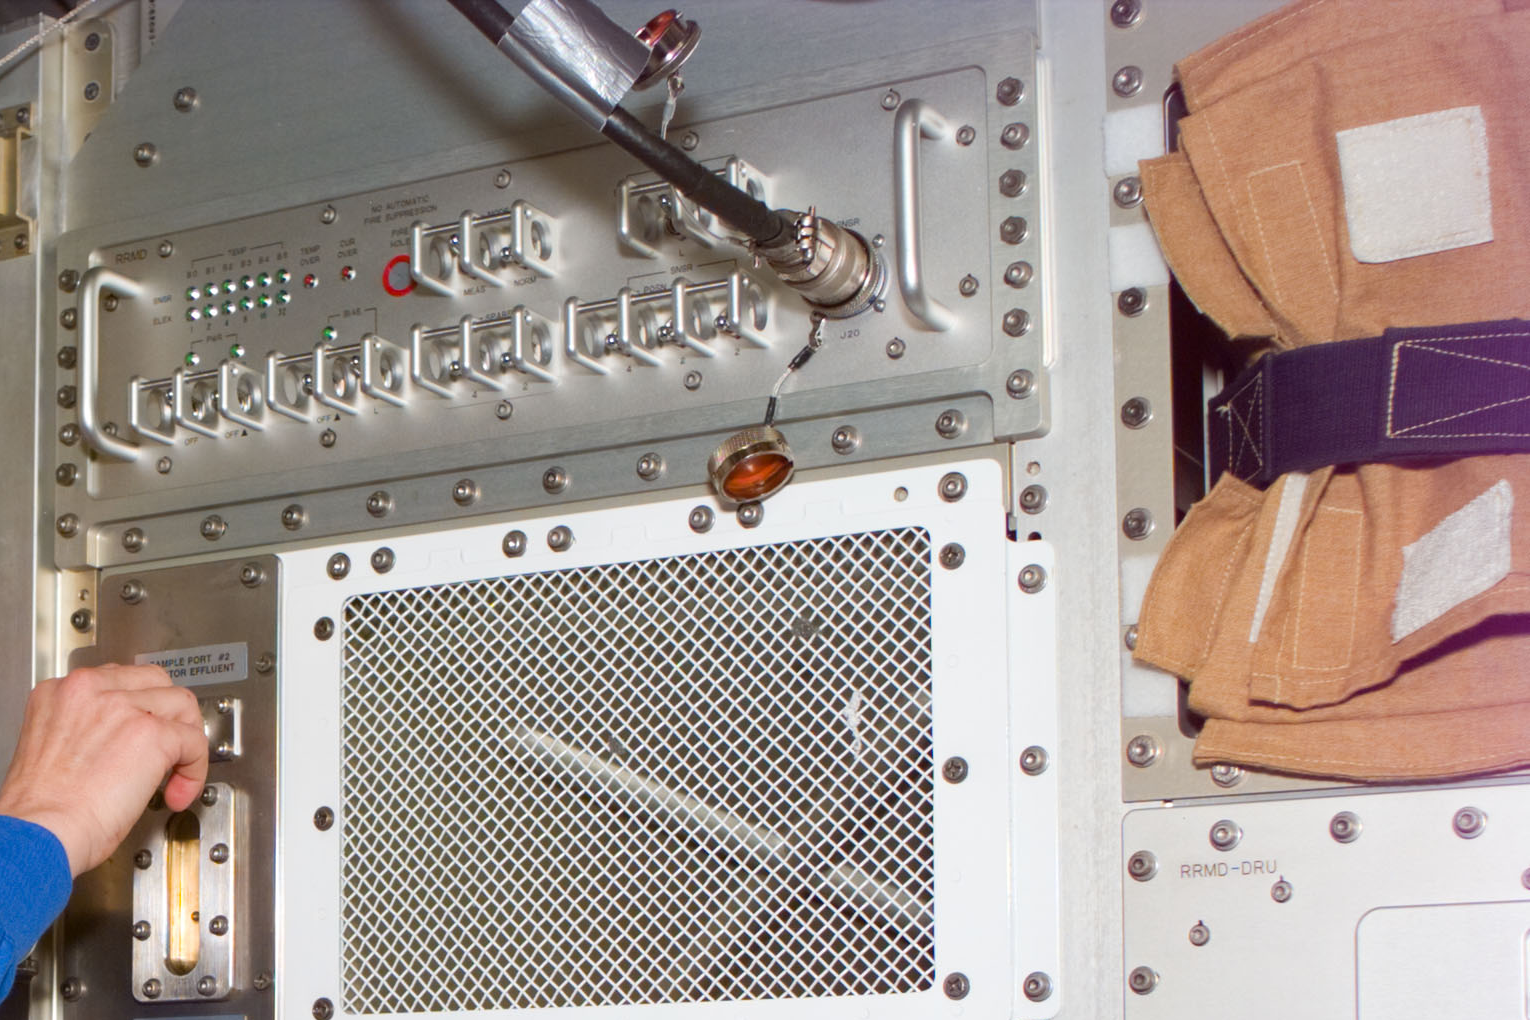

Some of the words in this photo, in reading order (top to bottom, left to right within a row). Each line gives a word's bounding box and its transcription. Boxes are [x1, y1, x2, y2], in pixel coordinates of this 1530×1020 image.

[386, 194, 430, 209] AUTOMATIC
[364, 216, 381, 225] FIRE
[385, 205, 437, 222] SUPPRESSION
[115, 248, 148, 264] RRMD
[228, 246, 247, 256] TEMP
[300, 244, 321, 255] TEMP
[337, 248, 358, 259] OVER
[300, 255, 320, 267] OVER
[463, 285, 486, 297] MEAS
[839, 327, 862, 341] J20
[188, 654, 211, 666] PORT
[218, 653, 231, 662] #2
[190, 662, 235, 677] EFFLUENT
[1180, 859, 1277, 879] RRMD-DRU
